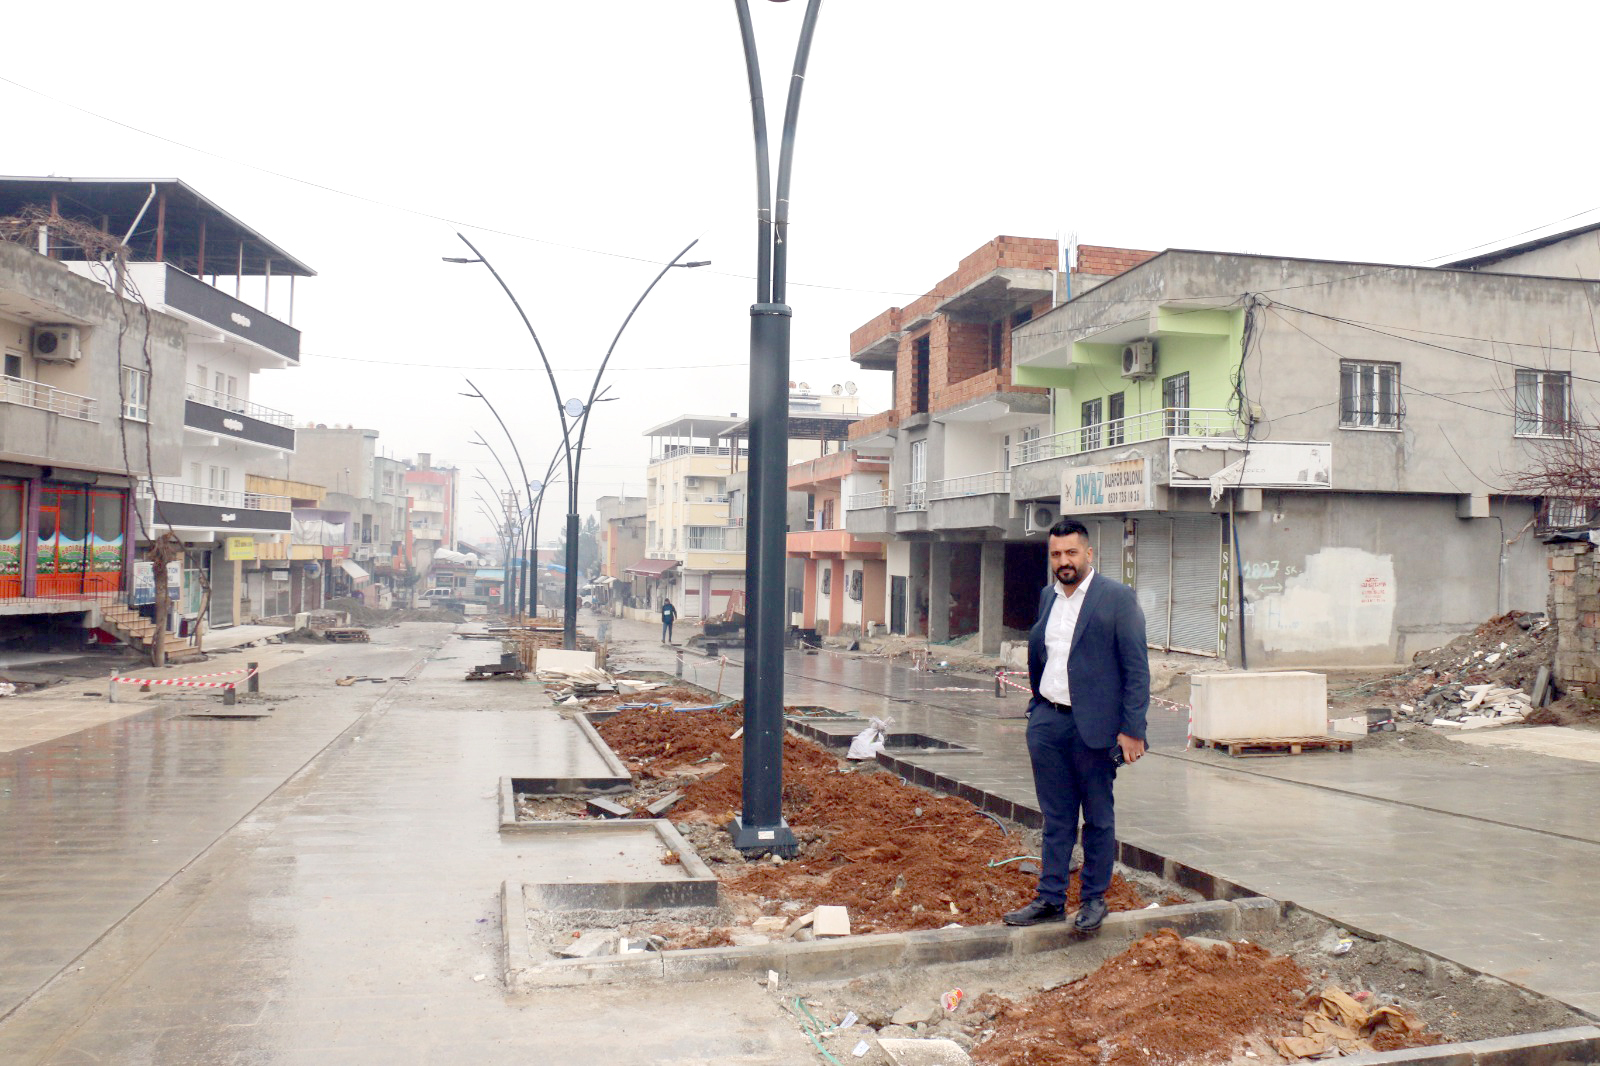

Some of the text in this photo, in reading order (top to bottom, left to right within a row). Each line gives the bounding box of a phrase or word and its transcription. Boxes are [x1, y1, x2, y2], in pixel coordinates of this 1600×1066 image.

[1075, 471, 1104, 506] AWAZ
[1123, 470, 1143, 486] SALONU
[1243, 560, 1280, 579] 1827
[1220, 551, 1229, 652] SALONU
